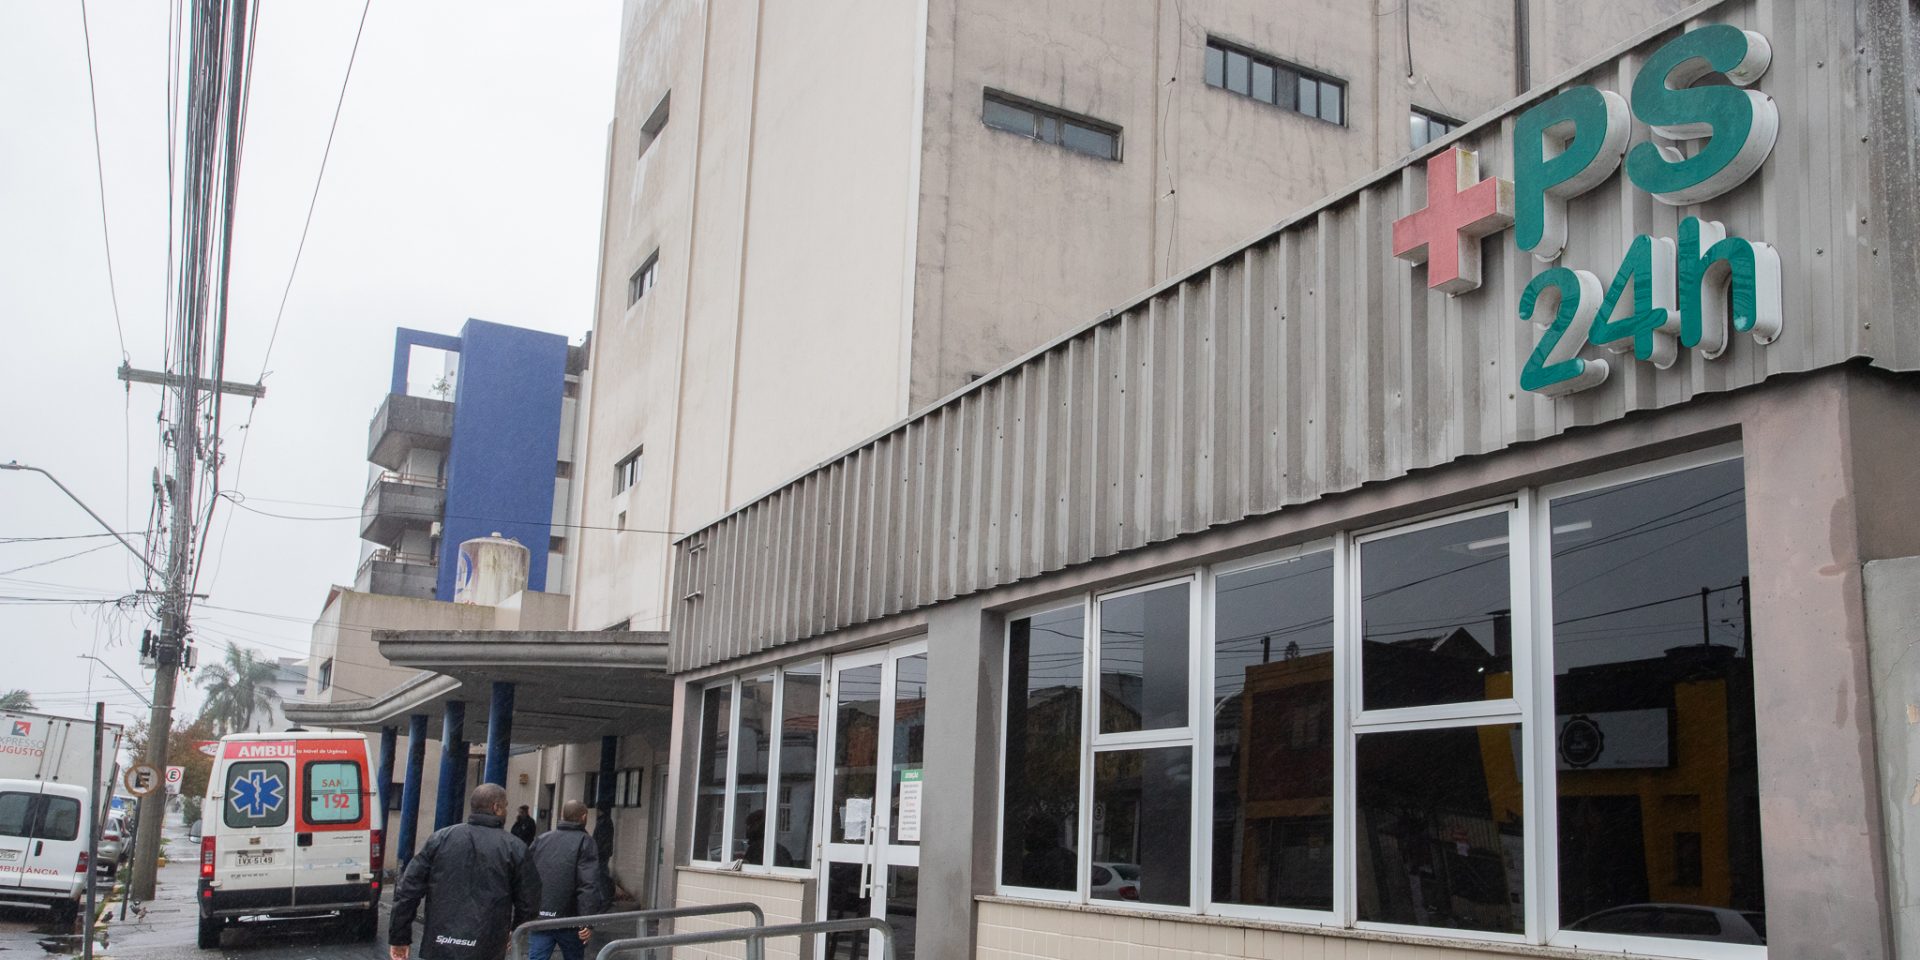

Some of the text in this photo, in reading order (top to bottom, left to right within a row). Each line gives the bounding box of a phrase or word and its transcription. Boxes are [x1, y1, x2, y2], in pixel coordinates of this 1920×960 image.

[1514, 24, 1756, 253] PS
[1519, 216, 1757, 393] 24h
[0, 736, 45, 749] XPRESSO
[0, 744, 43, 758] UGUSTO
[135, 771, 151, 788] E
[169, 770, 177, 780] E
[323, 793, 350, 809] 192
[0, 865, 59, 876] MBULÂNCIA
[436, 935, 477, 947] Spinesul
